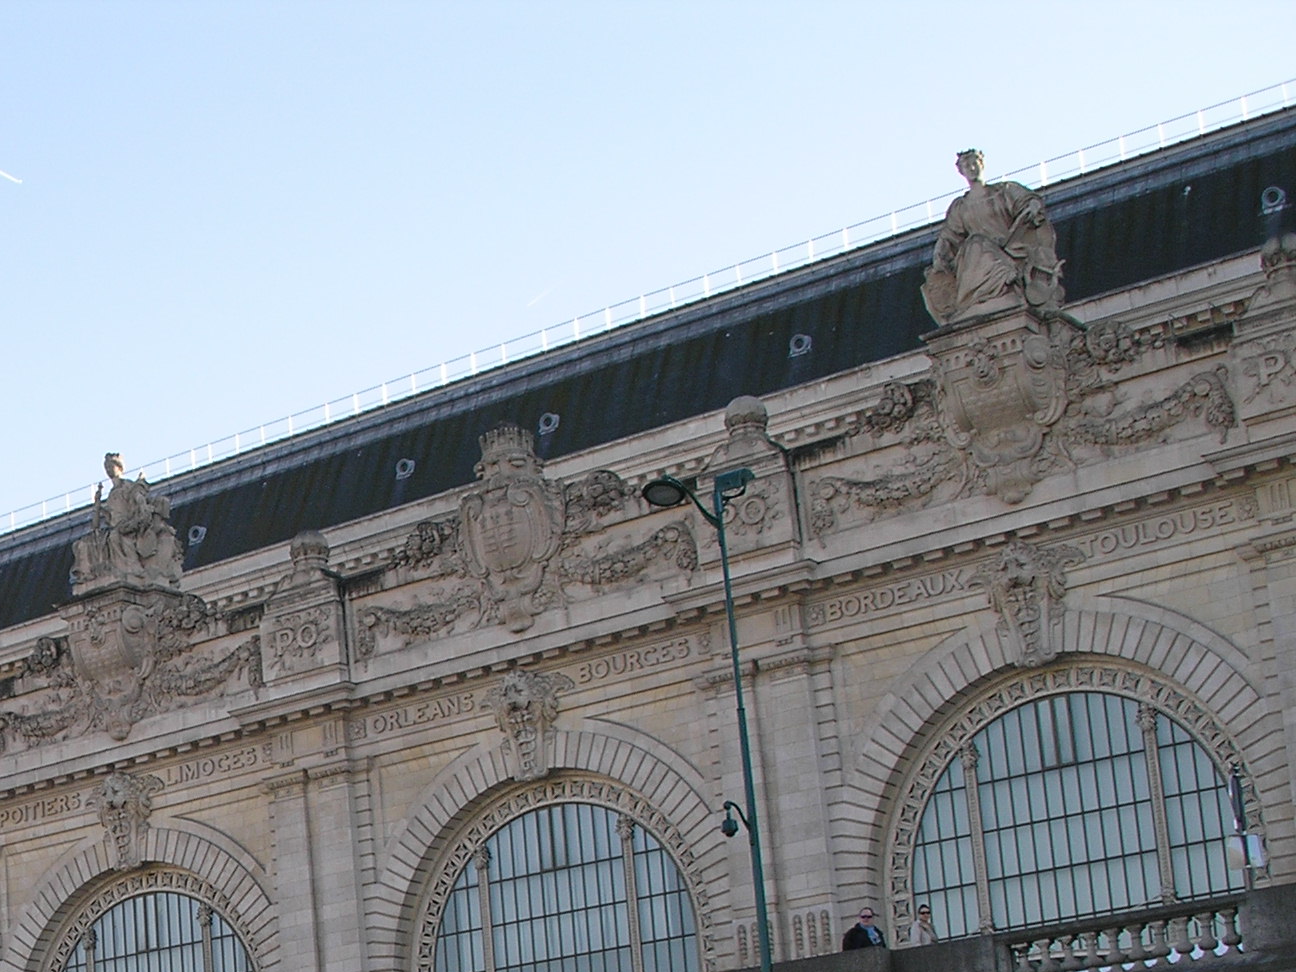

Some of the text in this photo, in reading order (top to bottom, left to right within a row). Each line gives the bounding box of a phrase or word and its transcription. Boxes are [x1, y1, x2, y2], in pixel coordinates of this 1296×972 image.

[1078, 501, 1234, 560] TOULOUSE
[825, 570, 967, 624] BORDEAUX
[578, 637, 692, 685] BOURGES
[371, 693, 475, 736] ORLEANS
[164, 747, 258, 788] LIMOGES
